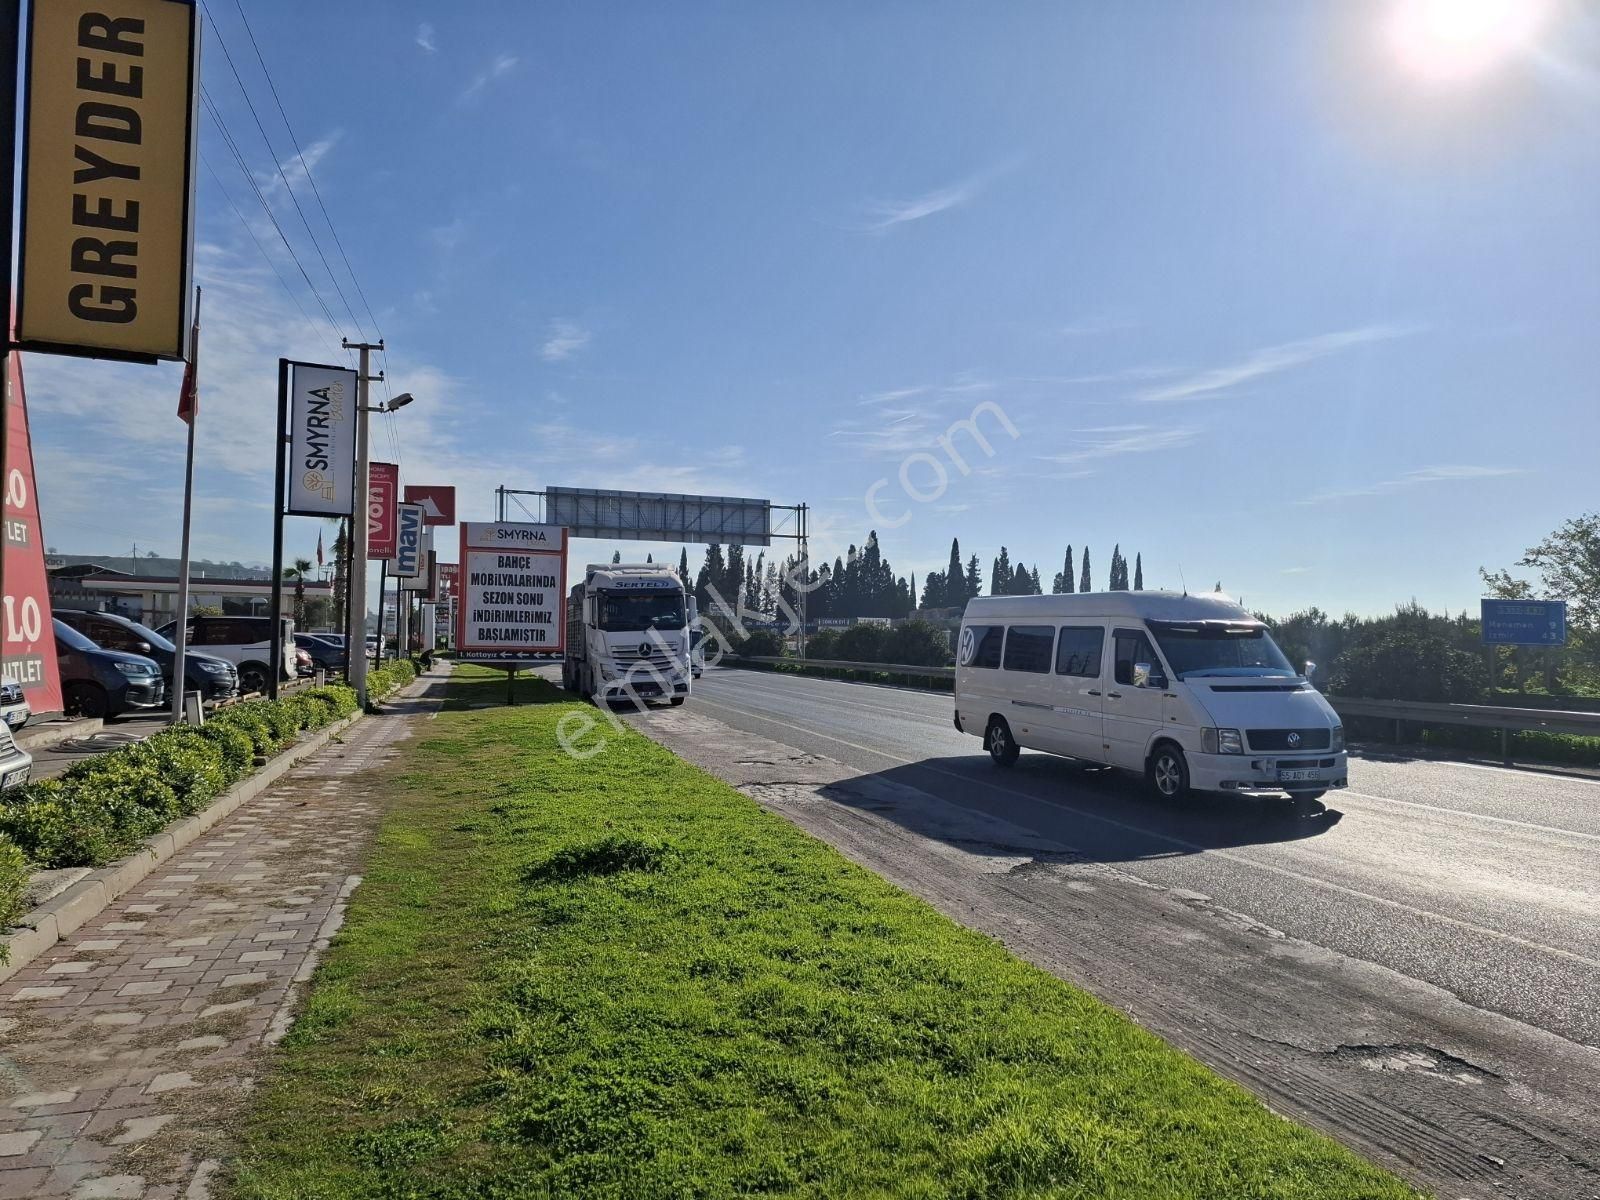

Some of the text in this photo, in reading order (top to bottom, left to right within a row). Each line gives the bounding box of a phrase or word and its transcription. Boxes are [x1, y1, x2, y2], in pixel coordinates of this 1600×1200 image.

[68, 12, 145, 324] GREYDER
[305, 387, 330, 471] SMYRNA
[398, 508, 419, 572] mavi
[497, 528, 547, 541] SMYRNA
[498, 555, 531, 571] BAHÇE
[482, 591, 544, 606] SEZON SONU
[478, 628, 546, 643] BAŞLAMIŞTIR
